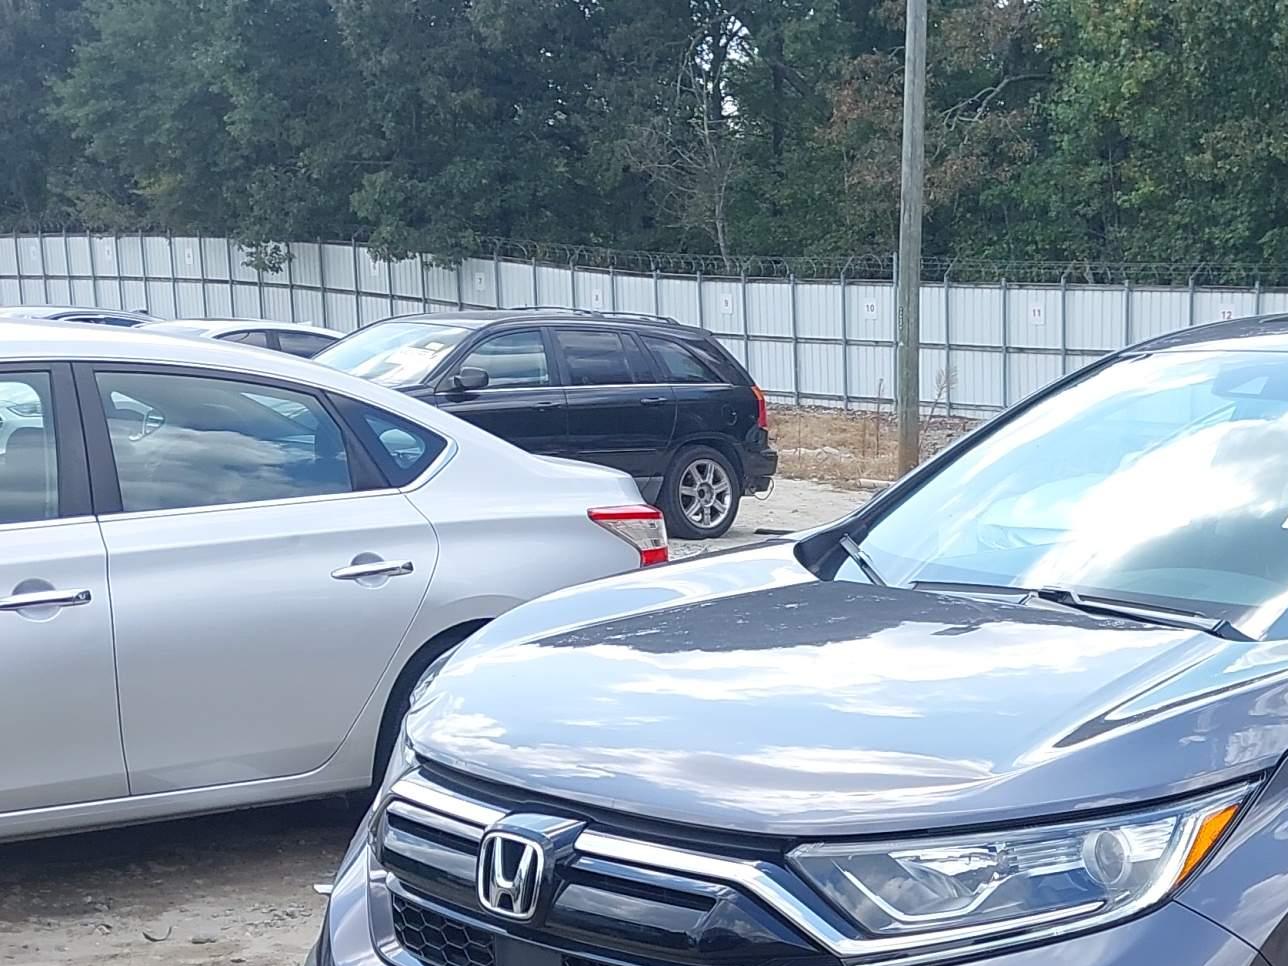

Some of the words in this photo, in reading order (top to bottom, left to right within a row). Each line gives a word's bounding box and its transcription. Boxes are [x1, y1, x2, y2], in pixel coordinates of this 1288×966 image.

[865, 303, 876, 313] 10
[1031, 308, 1042, 318] 11
[1221, 310, 1233, 320] 12
